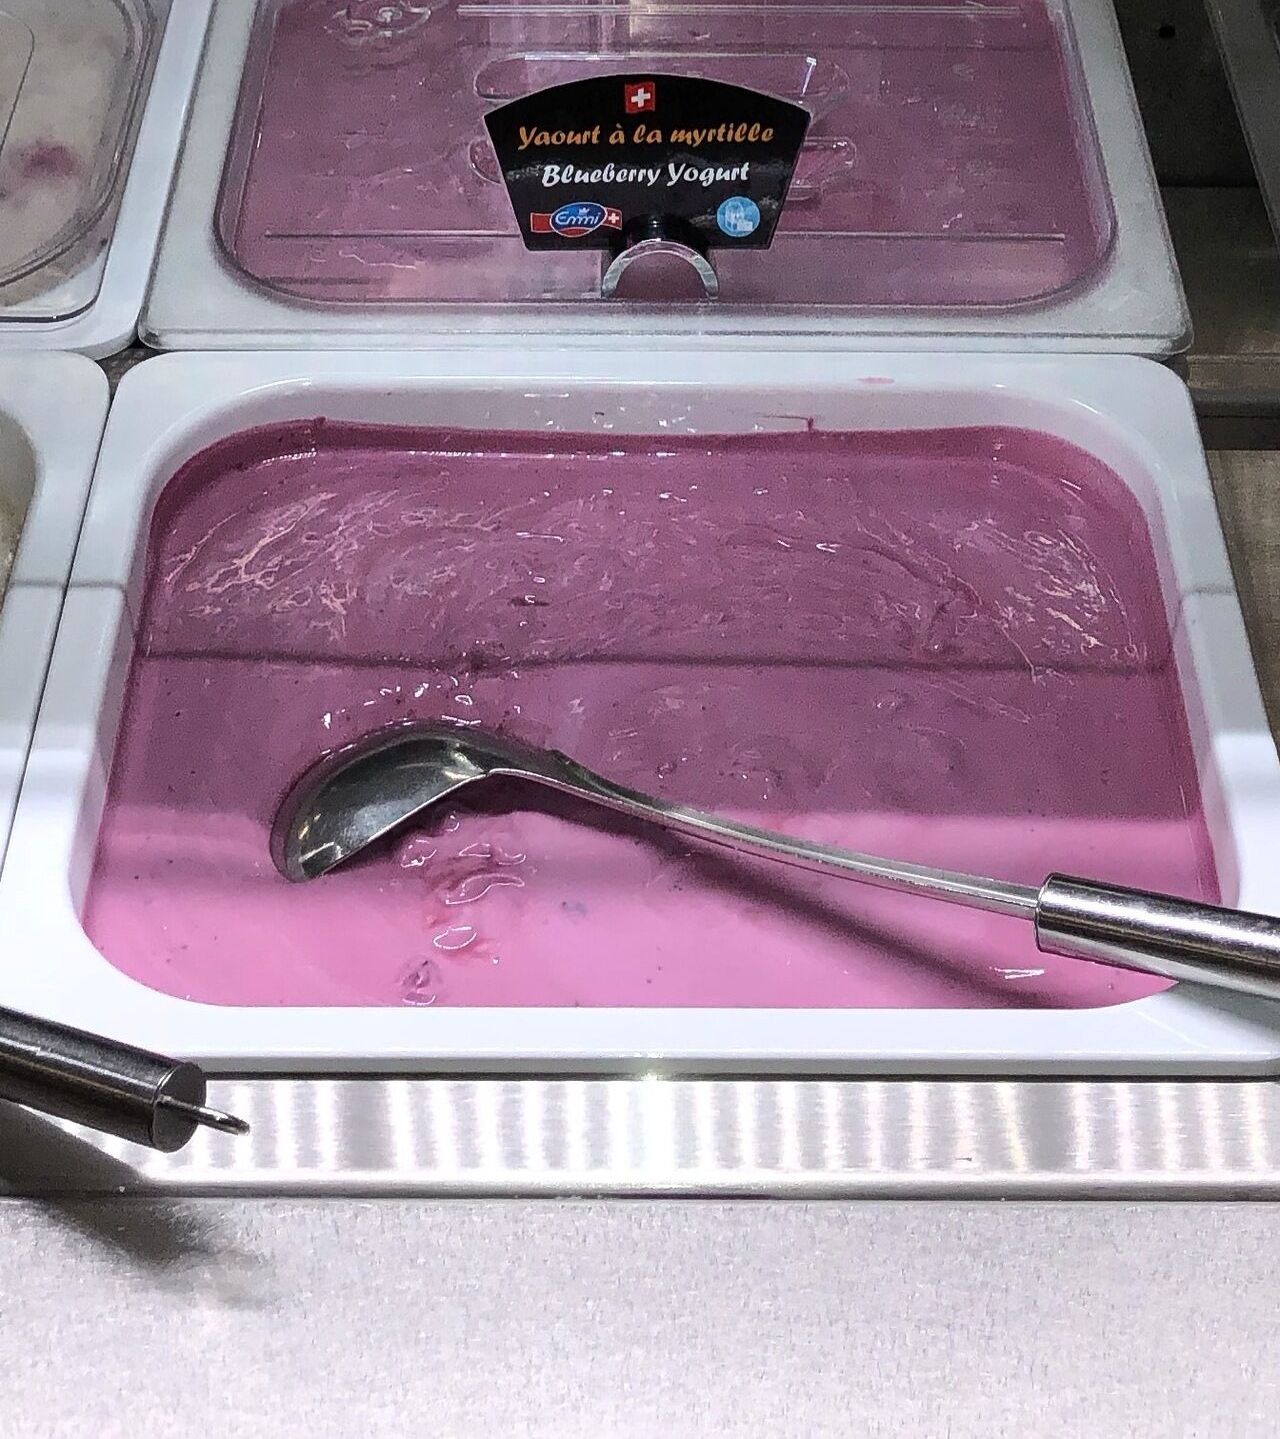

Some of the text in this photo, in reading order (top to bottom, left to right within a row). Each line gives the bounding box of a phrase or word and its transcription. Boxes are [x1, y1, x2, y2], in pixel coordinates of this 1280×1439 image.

[518, 122, 774, 151] Yaourt à la myrtille
[542, 162, 749, 187] Blueberry Yogurt
[555, 211, 601, 225] Emmi
